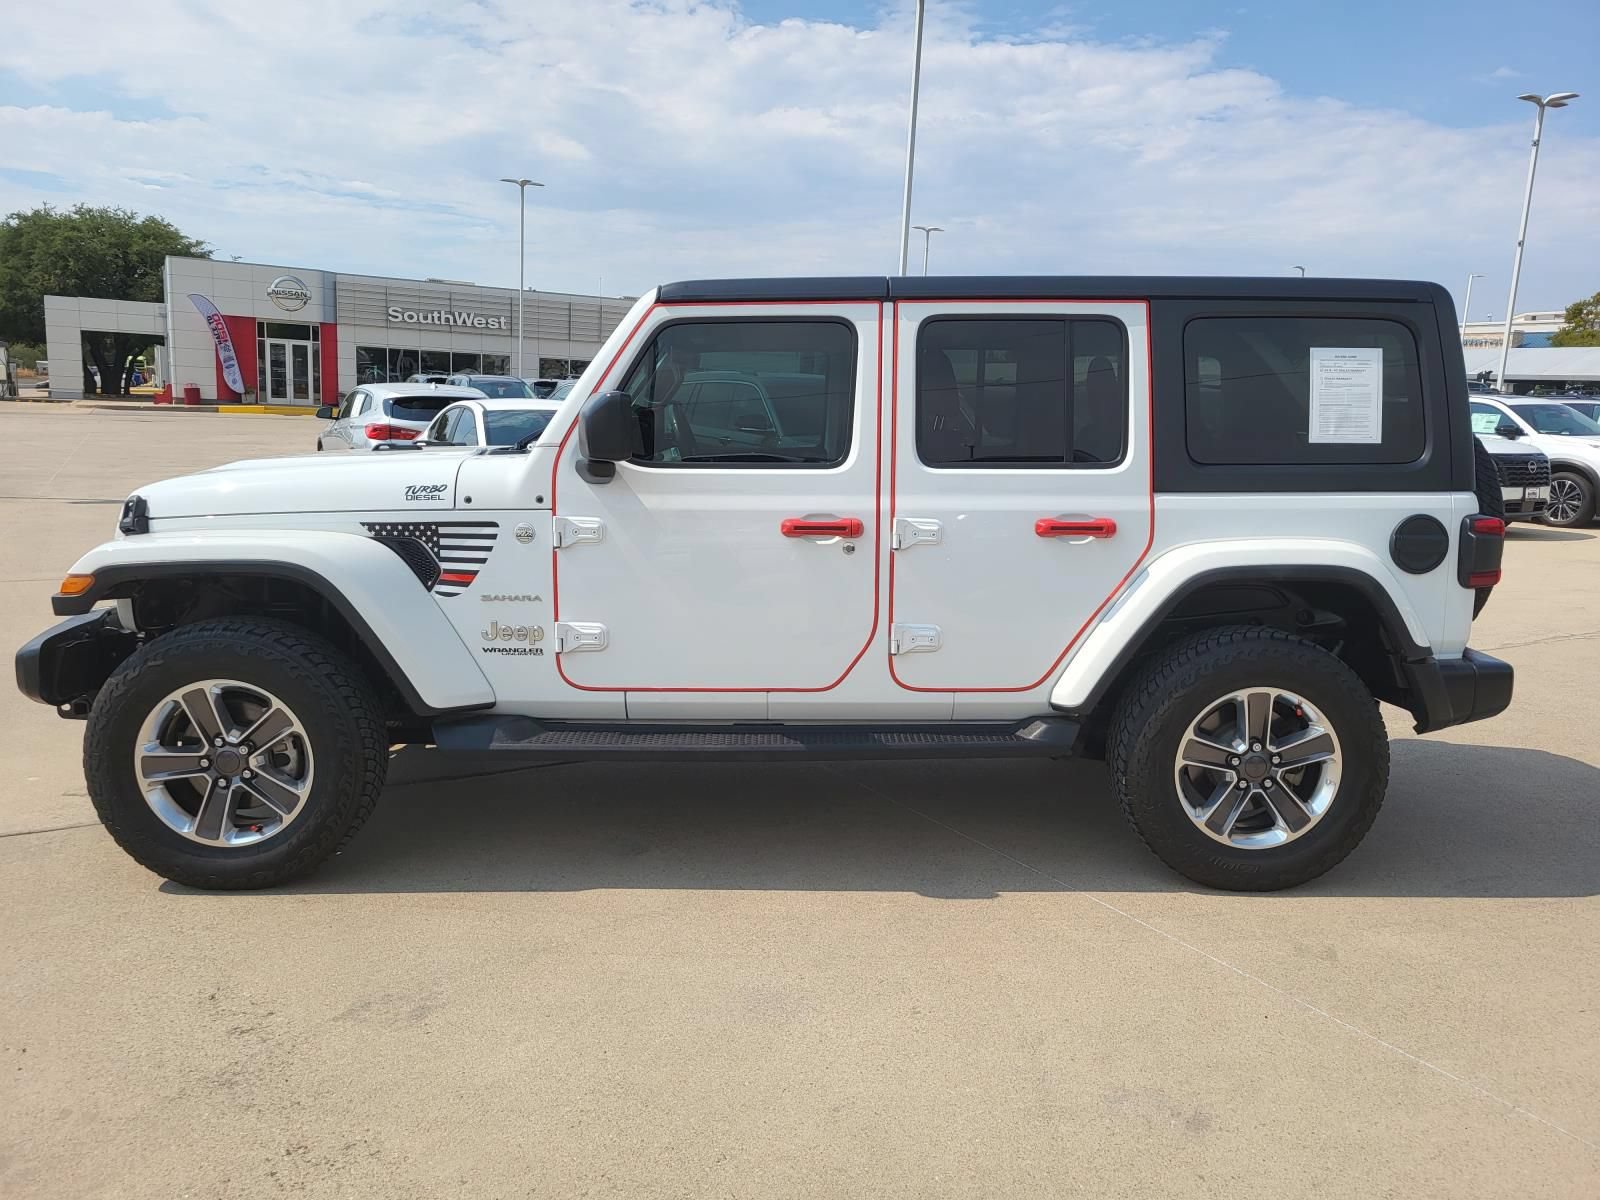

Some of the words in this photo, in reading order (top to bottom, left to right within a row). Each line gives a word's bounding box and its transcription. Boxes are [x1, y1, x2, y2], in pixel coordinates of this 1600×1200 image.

[271, 289, 307, 298] NISSAN
[387, 306, 507, 329] SouthWest
[405, 484, 448, 495] TURBO
[480, 594, 543, 602] SAHARA
[481, 620, 545, 646] Jeep
